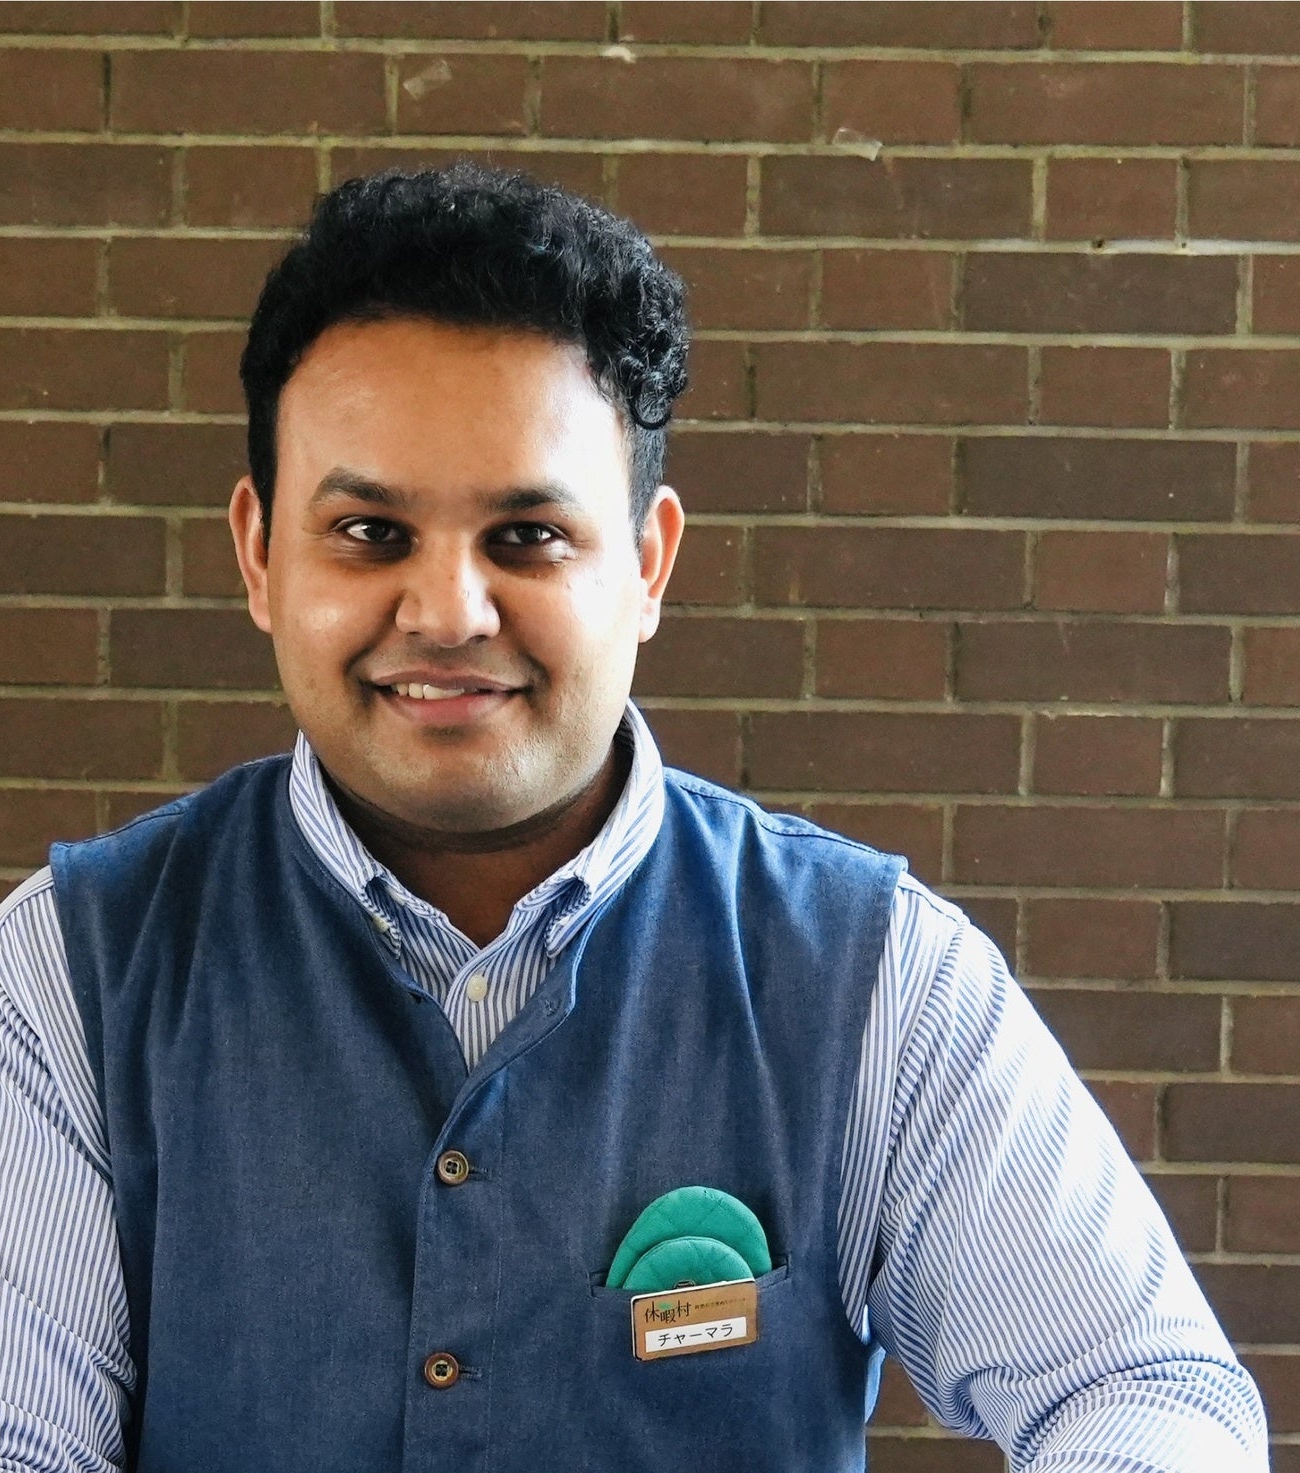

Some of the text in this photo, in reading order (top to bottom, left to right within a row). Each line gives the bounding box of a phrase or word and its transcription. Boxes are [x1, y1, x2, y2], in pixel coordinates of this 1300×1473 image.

[644, 1299, 692, 1324] 休暇村
[657, 1323, 733, 1347] チャーマラ
